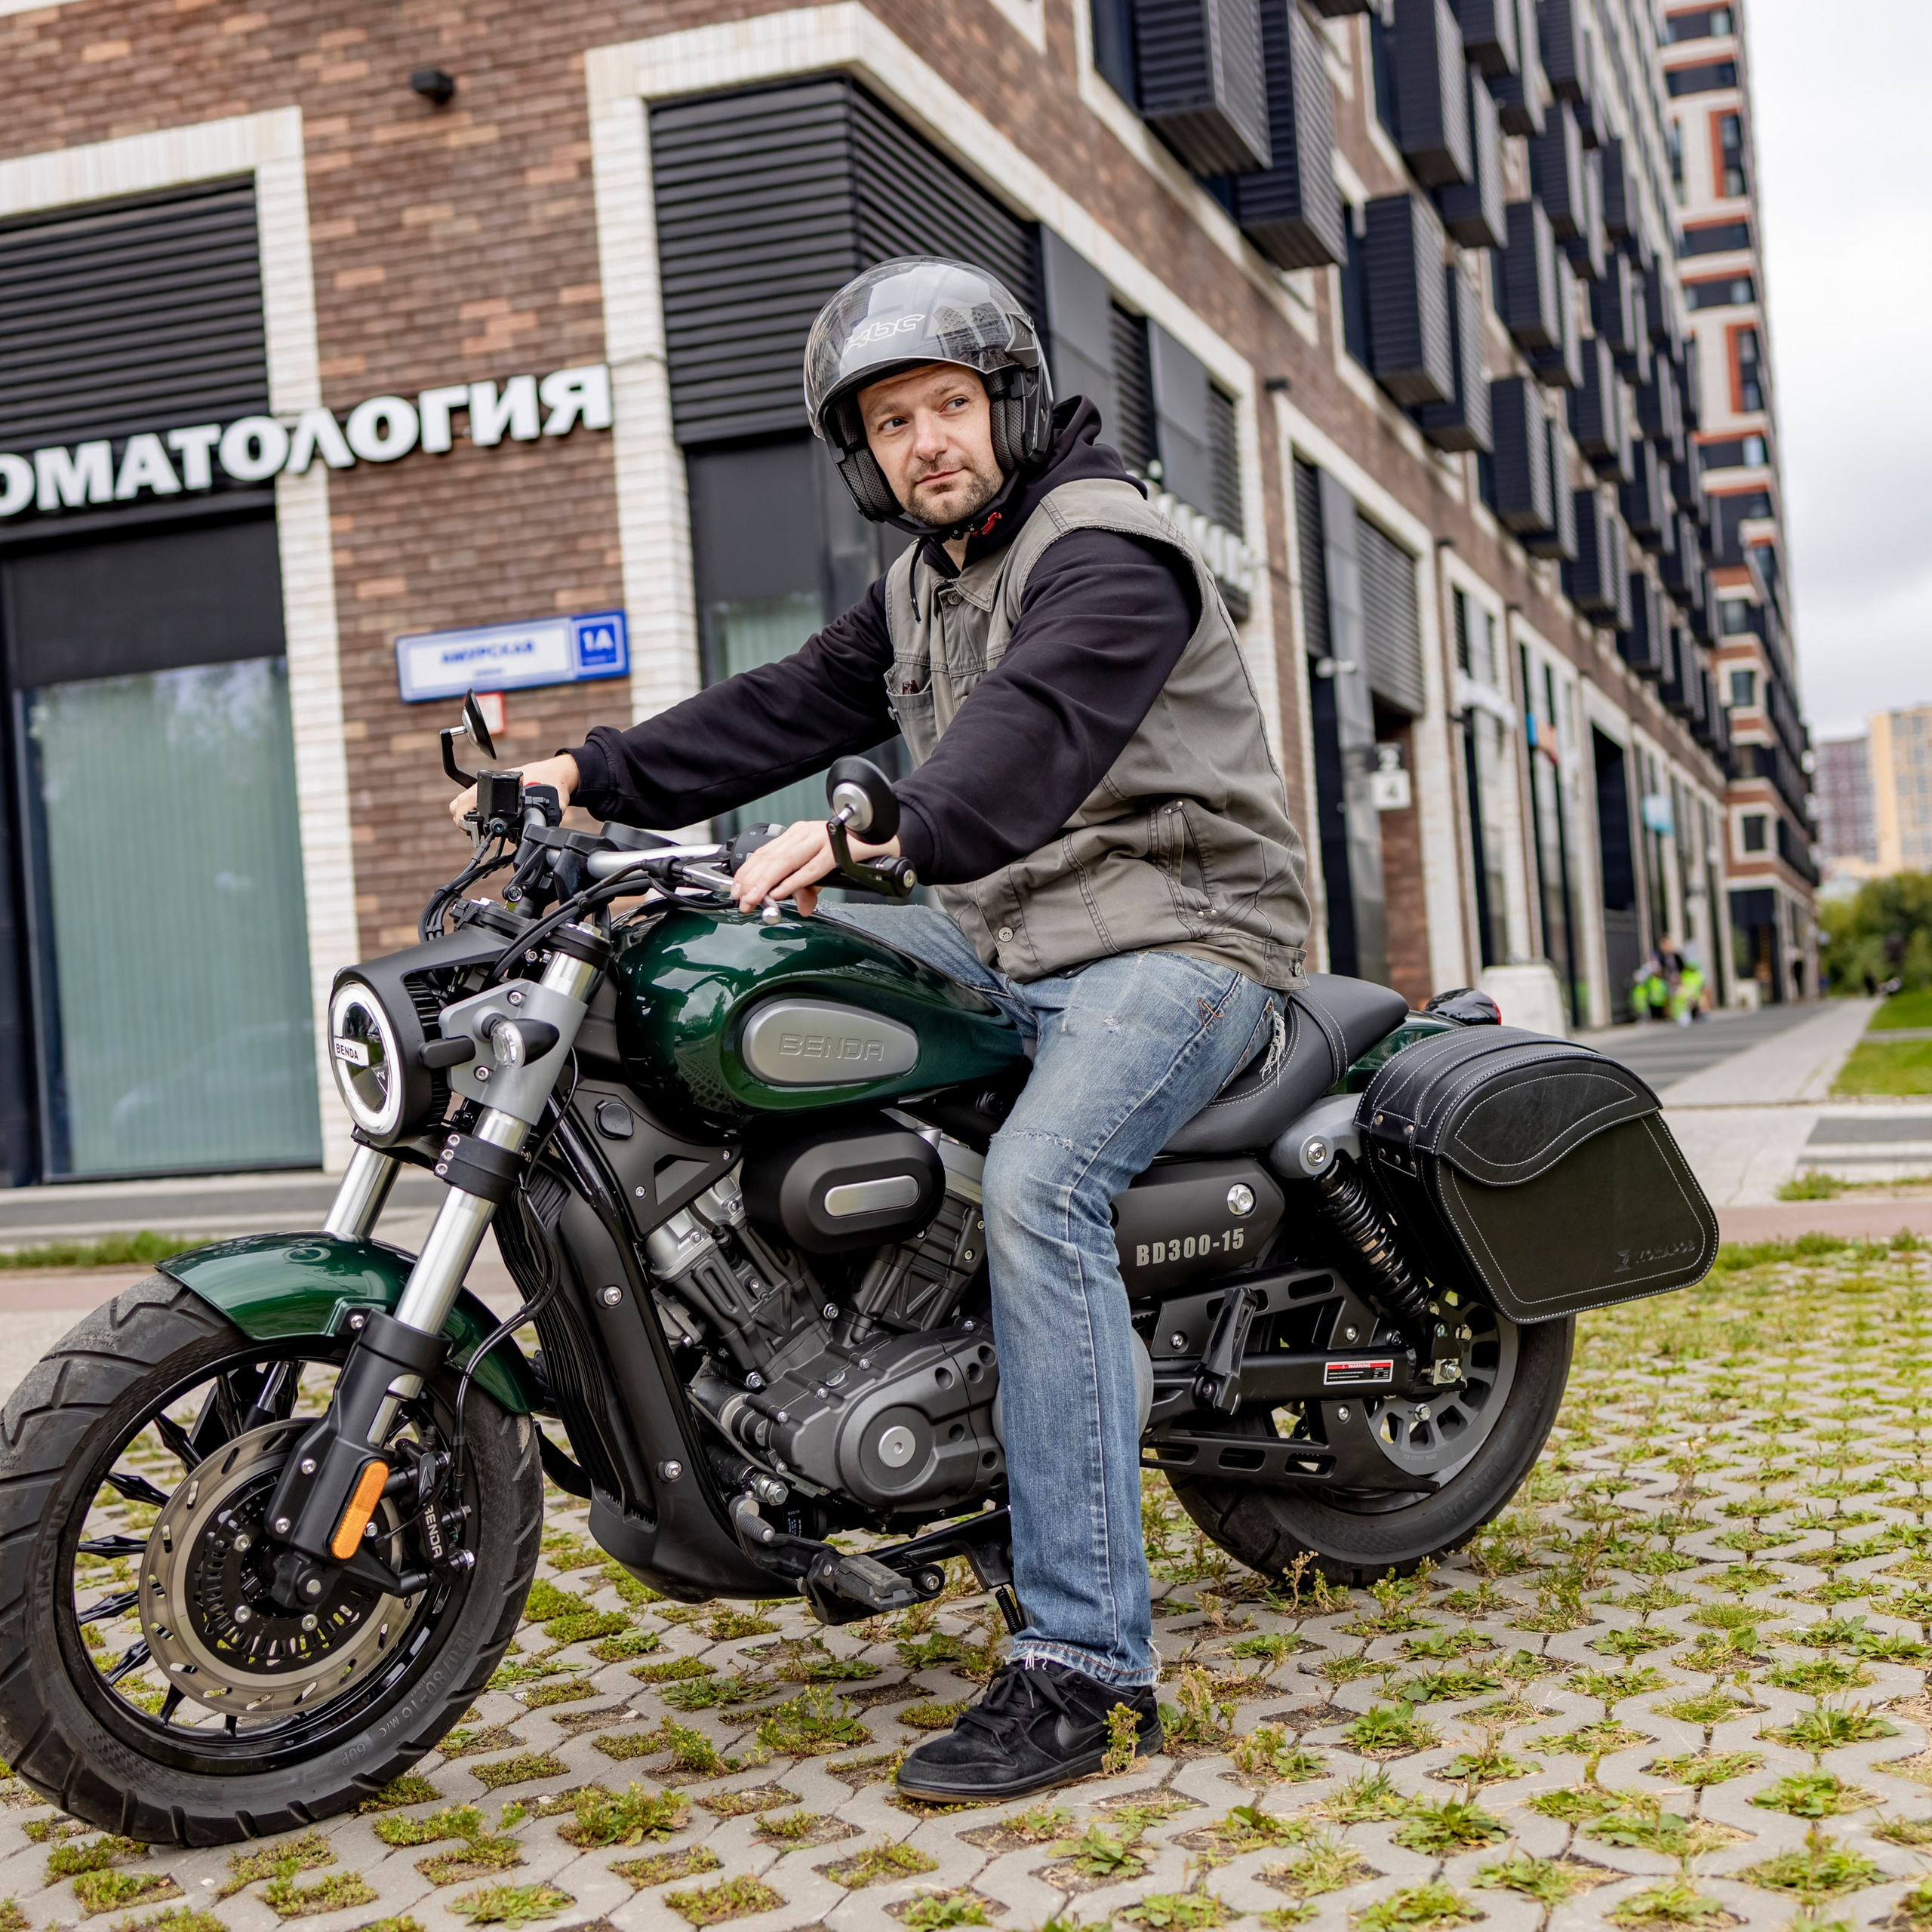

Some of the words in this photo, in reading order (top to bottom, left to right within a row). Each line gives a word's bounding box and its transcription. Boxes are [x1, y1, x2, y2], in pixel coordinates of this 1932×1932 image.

[582, 629, 614, 652] 1А
[336, 1042, 359, 1060] BENDA
[779, 1033, 884, 1061] BENDA
[1136, 1227, 1244, 1267] BD300-15
[424, 1504, 443, 1558] BENDA
